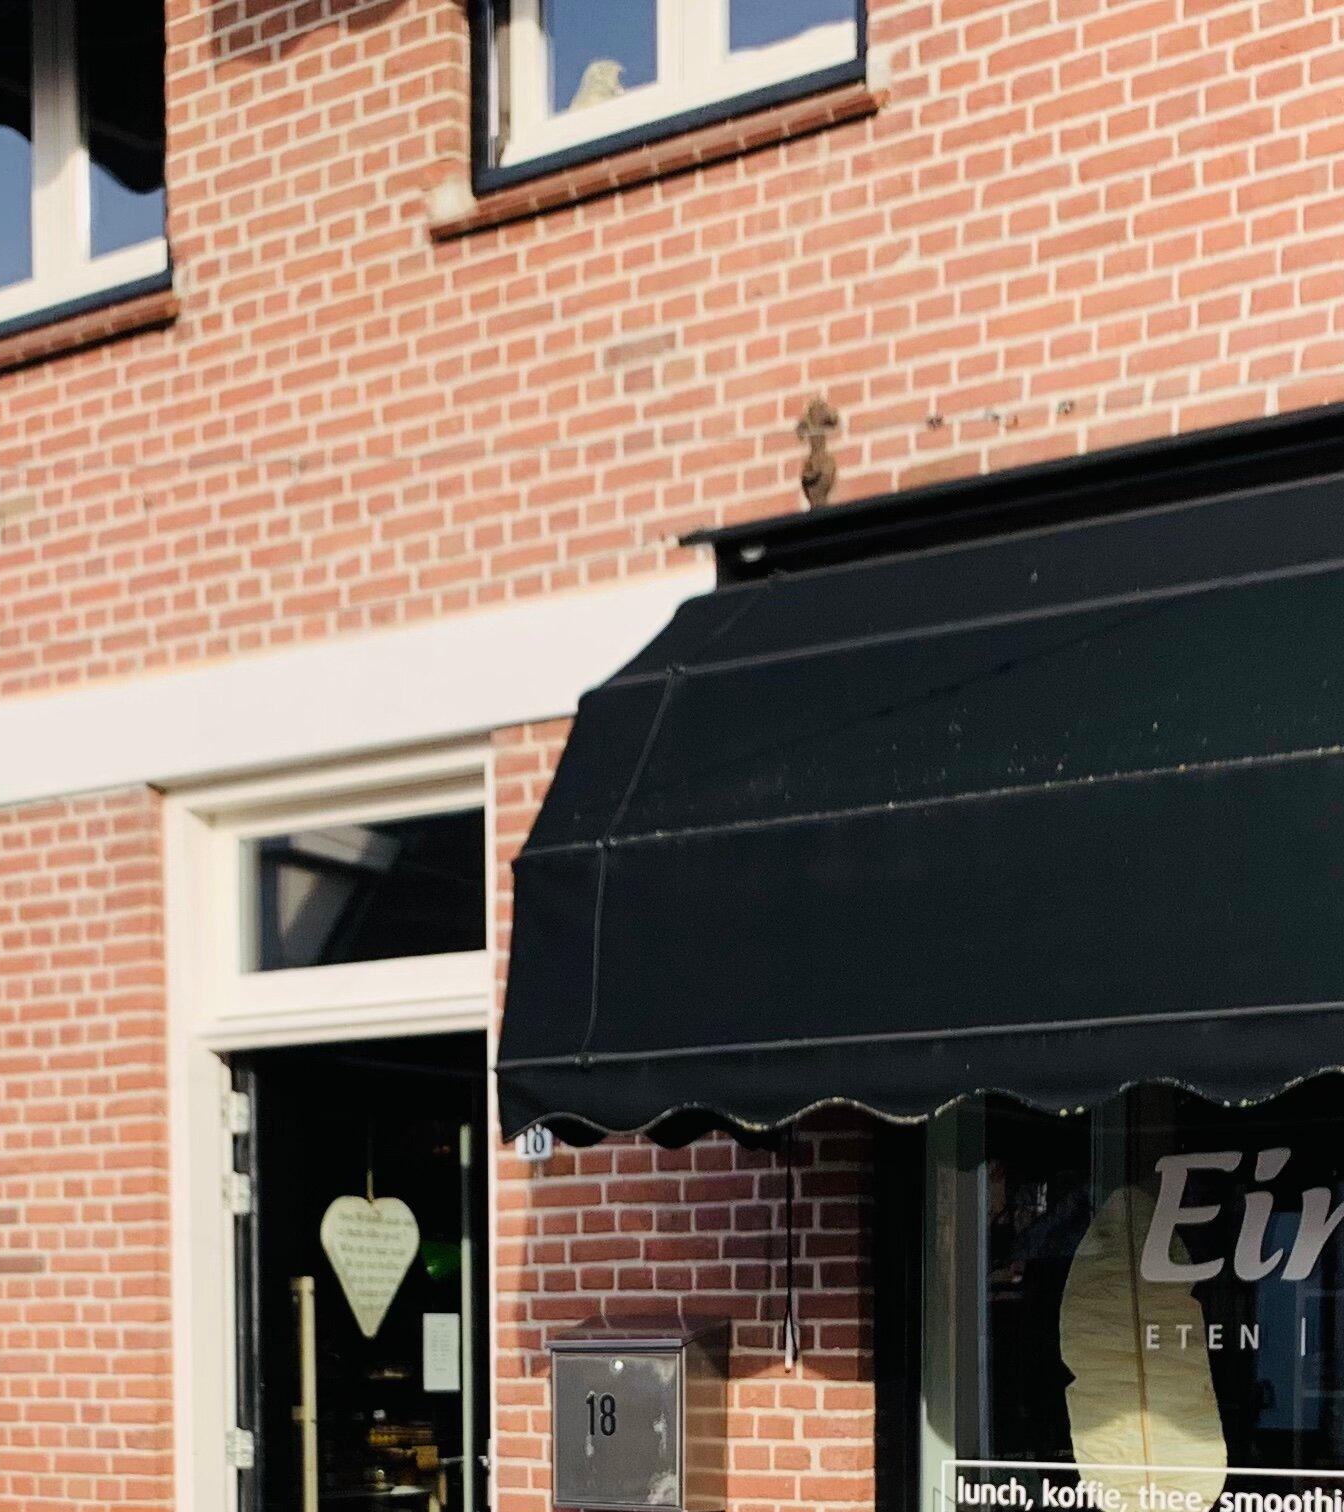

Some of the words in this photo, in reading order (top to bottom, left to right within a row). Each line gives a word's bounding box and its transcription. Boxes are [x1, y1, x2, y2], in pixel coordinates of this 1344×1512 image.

[1146, 1323, 1259, 1351] ETEN
[586, 1391, 616, 1436] 18
[957, 1475, 1034, 1511] lunch,
[1042, 1478, 1127, 1512] koffie,
